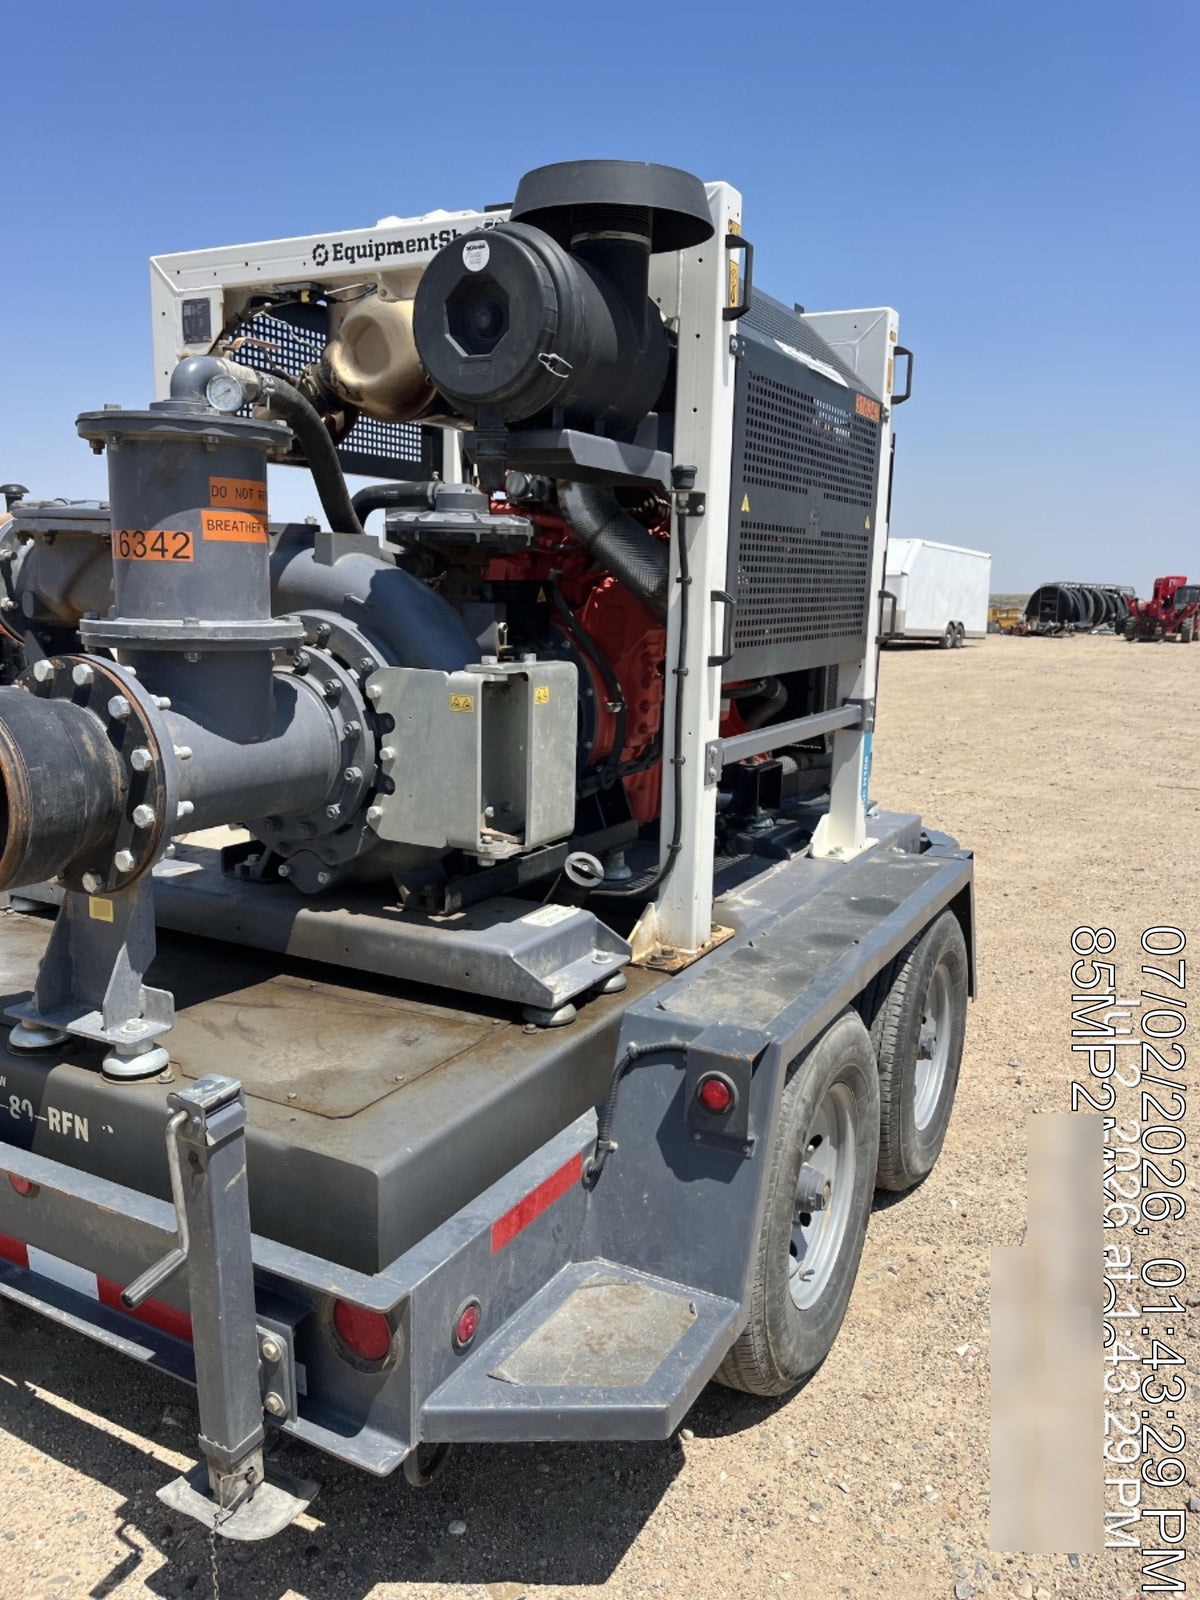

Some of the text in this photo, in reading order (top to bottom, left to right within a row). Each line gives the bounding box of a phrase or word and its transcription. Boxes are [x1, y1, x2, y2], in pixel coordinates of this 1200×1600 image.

[211, 485, 228, 498] DO
[235, 487, 254, 500] NOT
[207, 519, 262, 534] BREATHER
